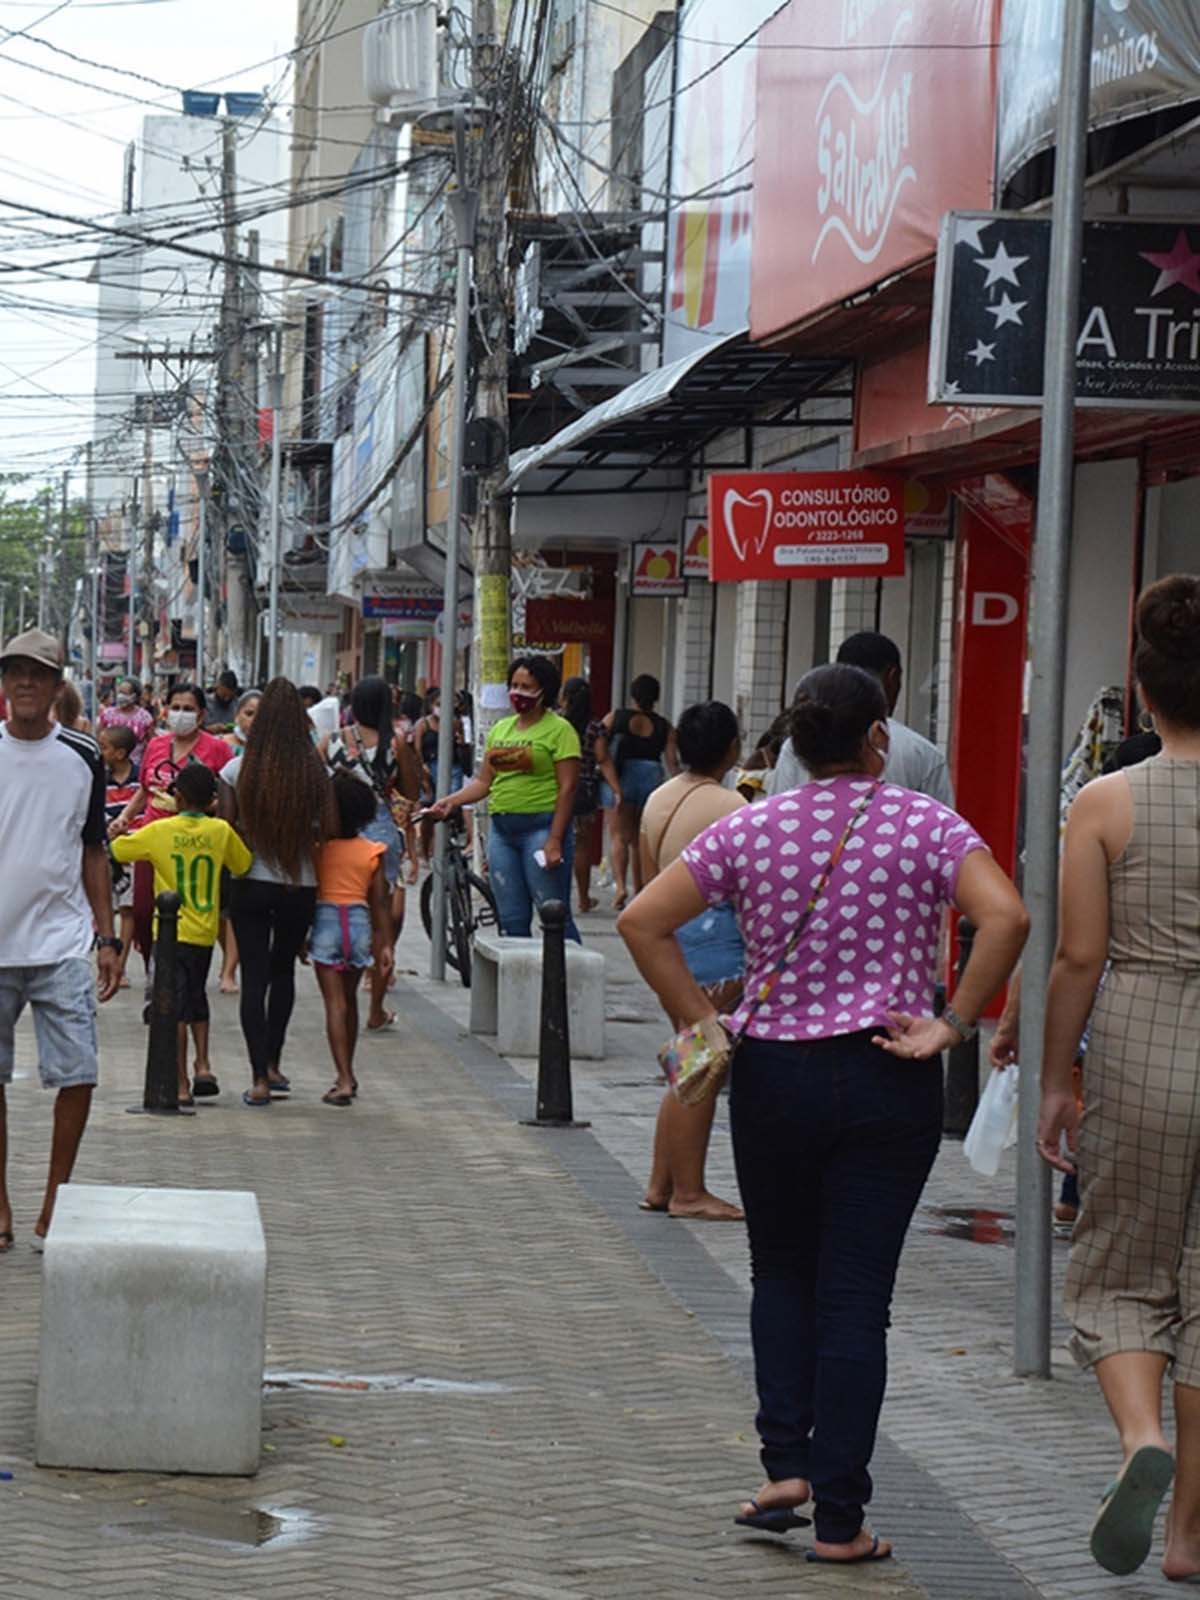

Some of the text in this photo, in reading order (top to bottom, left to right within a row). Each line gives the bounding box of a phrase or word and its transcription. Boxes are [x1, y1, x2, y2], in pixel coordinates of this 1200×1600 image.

[1076, 306, 1118, 358] A
[780, 484, 890, 507] CONSULTÓRIO
[773, 508, 898, 529] ODONTOLÓGICO
[972, 591, 1019, 626] D
[173, 833, 213, 849] BRASIL
[171, 854, 215, 913] 10
